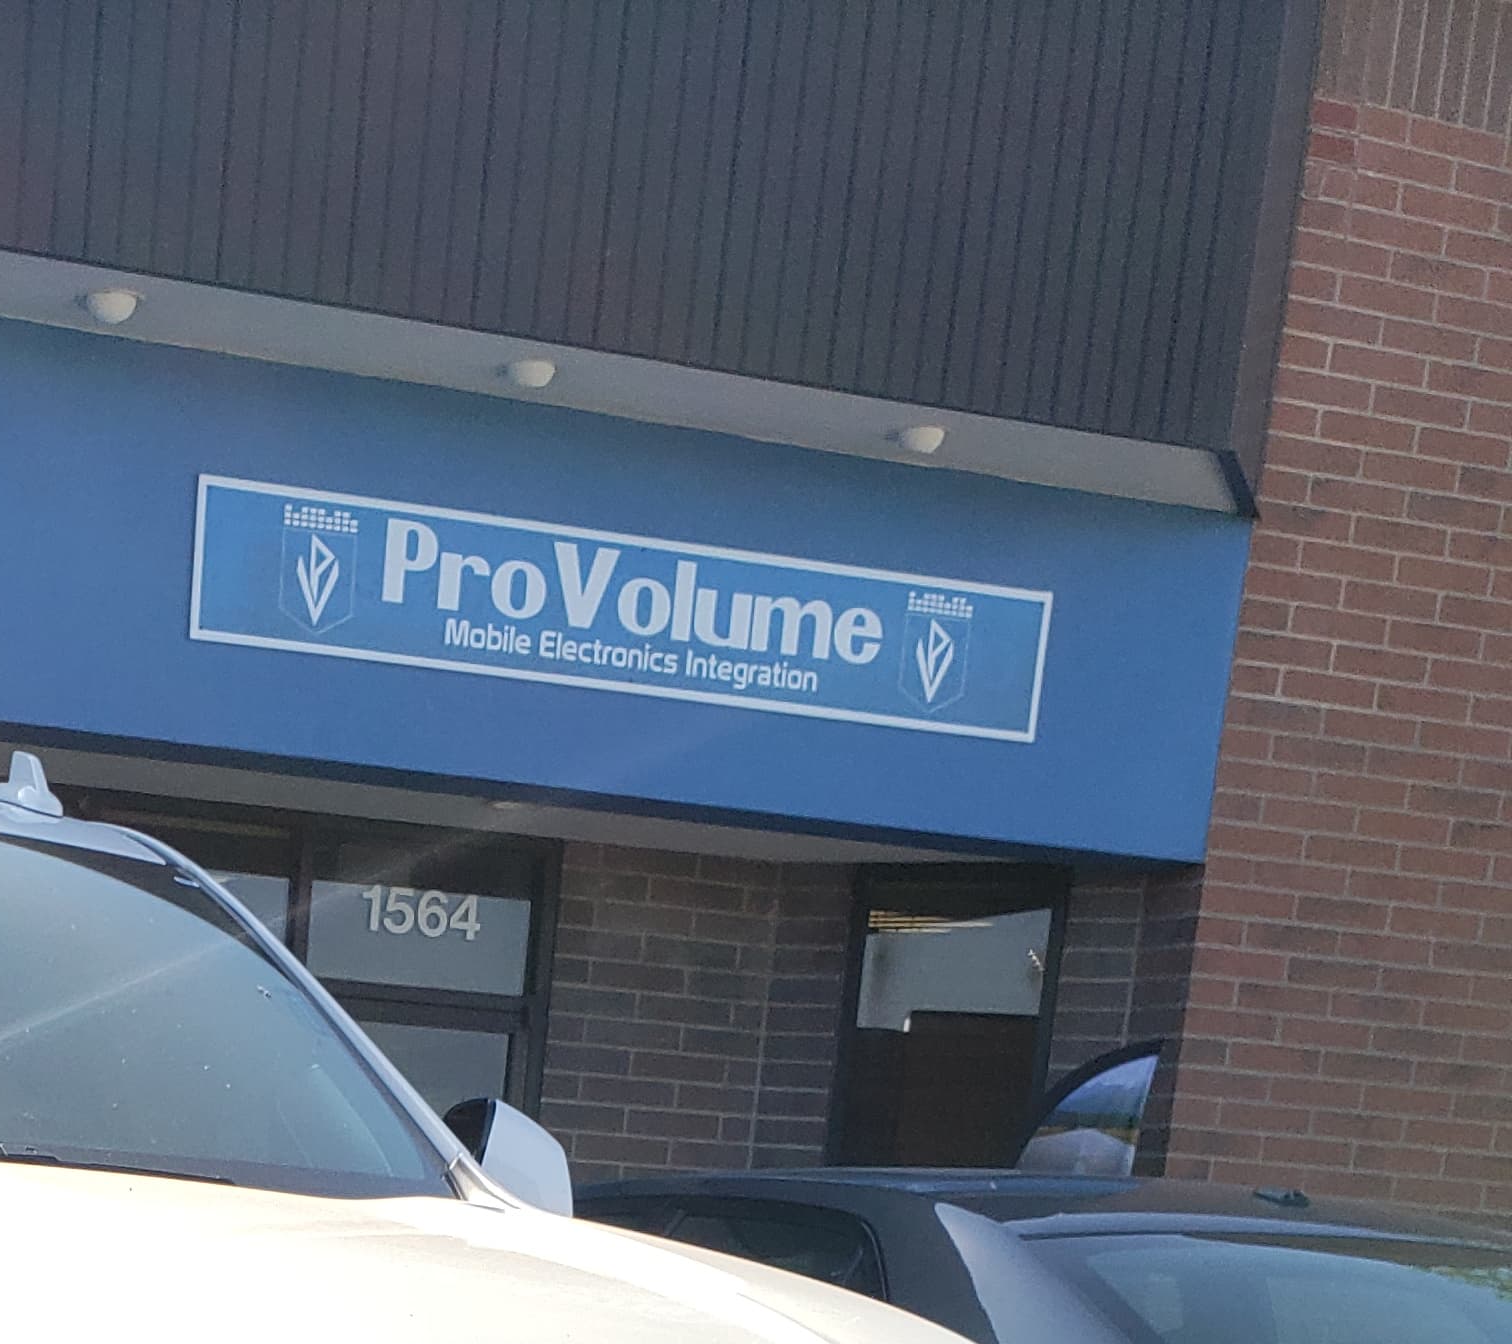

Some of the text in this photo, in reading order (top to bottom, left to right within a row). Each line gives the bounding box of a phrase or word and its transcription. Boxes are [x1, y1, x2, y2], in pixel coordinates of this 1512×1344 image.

[381, 517, 883, 664] ProVolume
[443, 618, 818, 691] Mobile Electronics Integration
[362, 884, 481, 940] 1564
